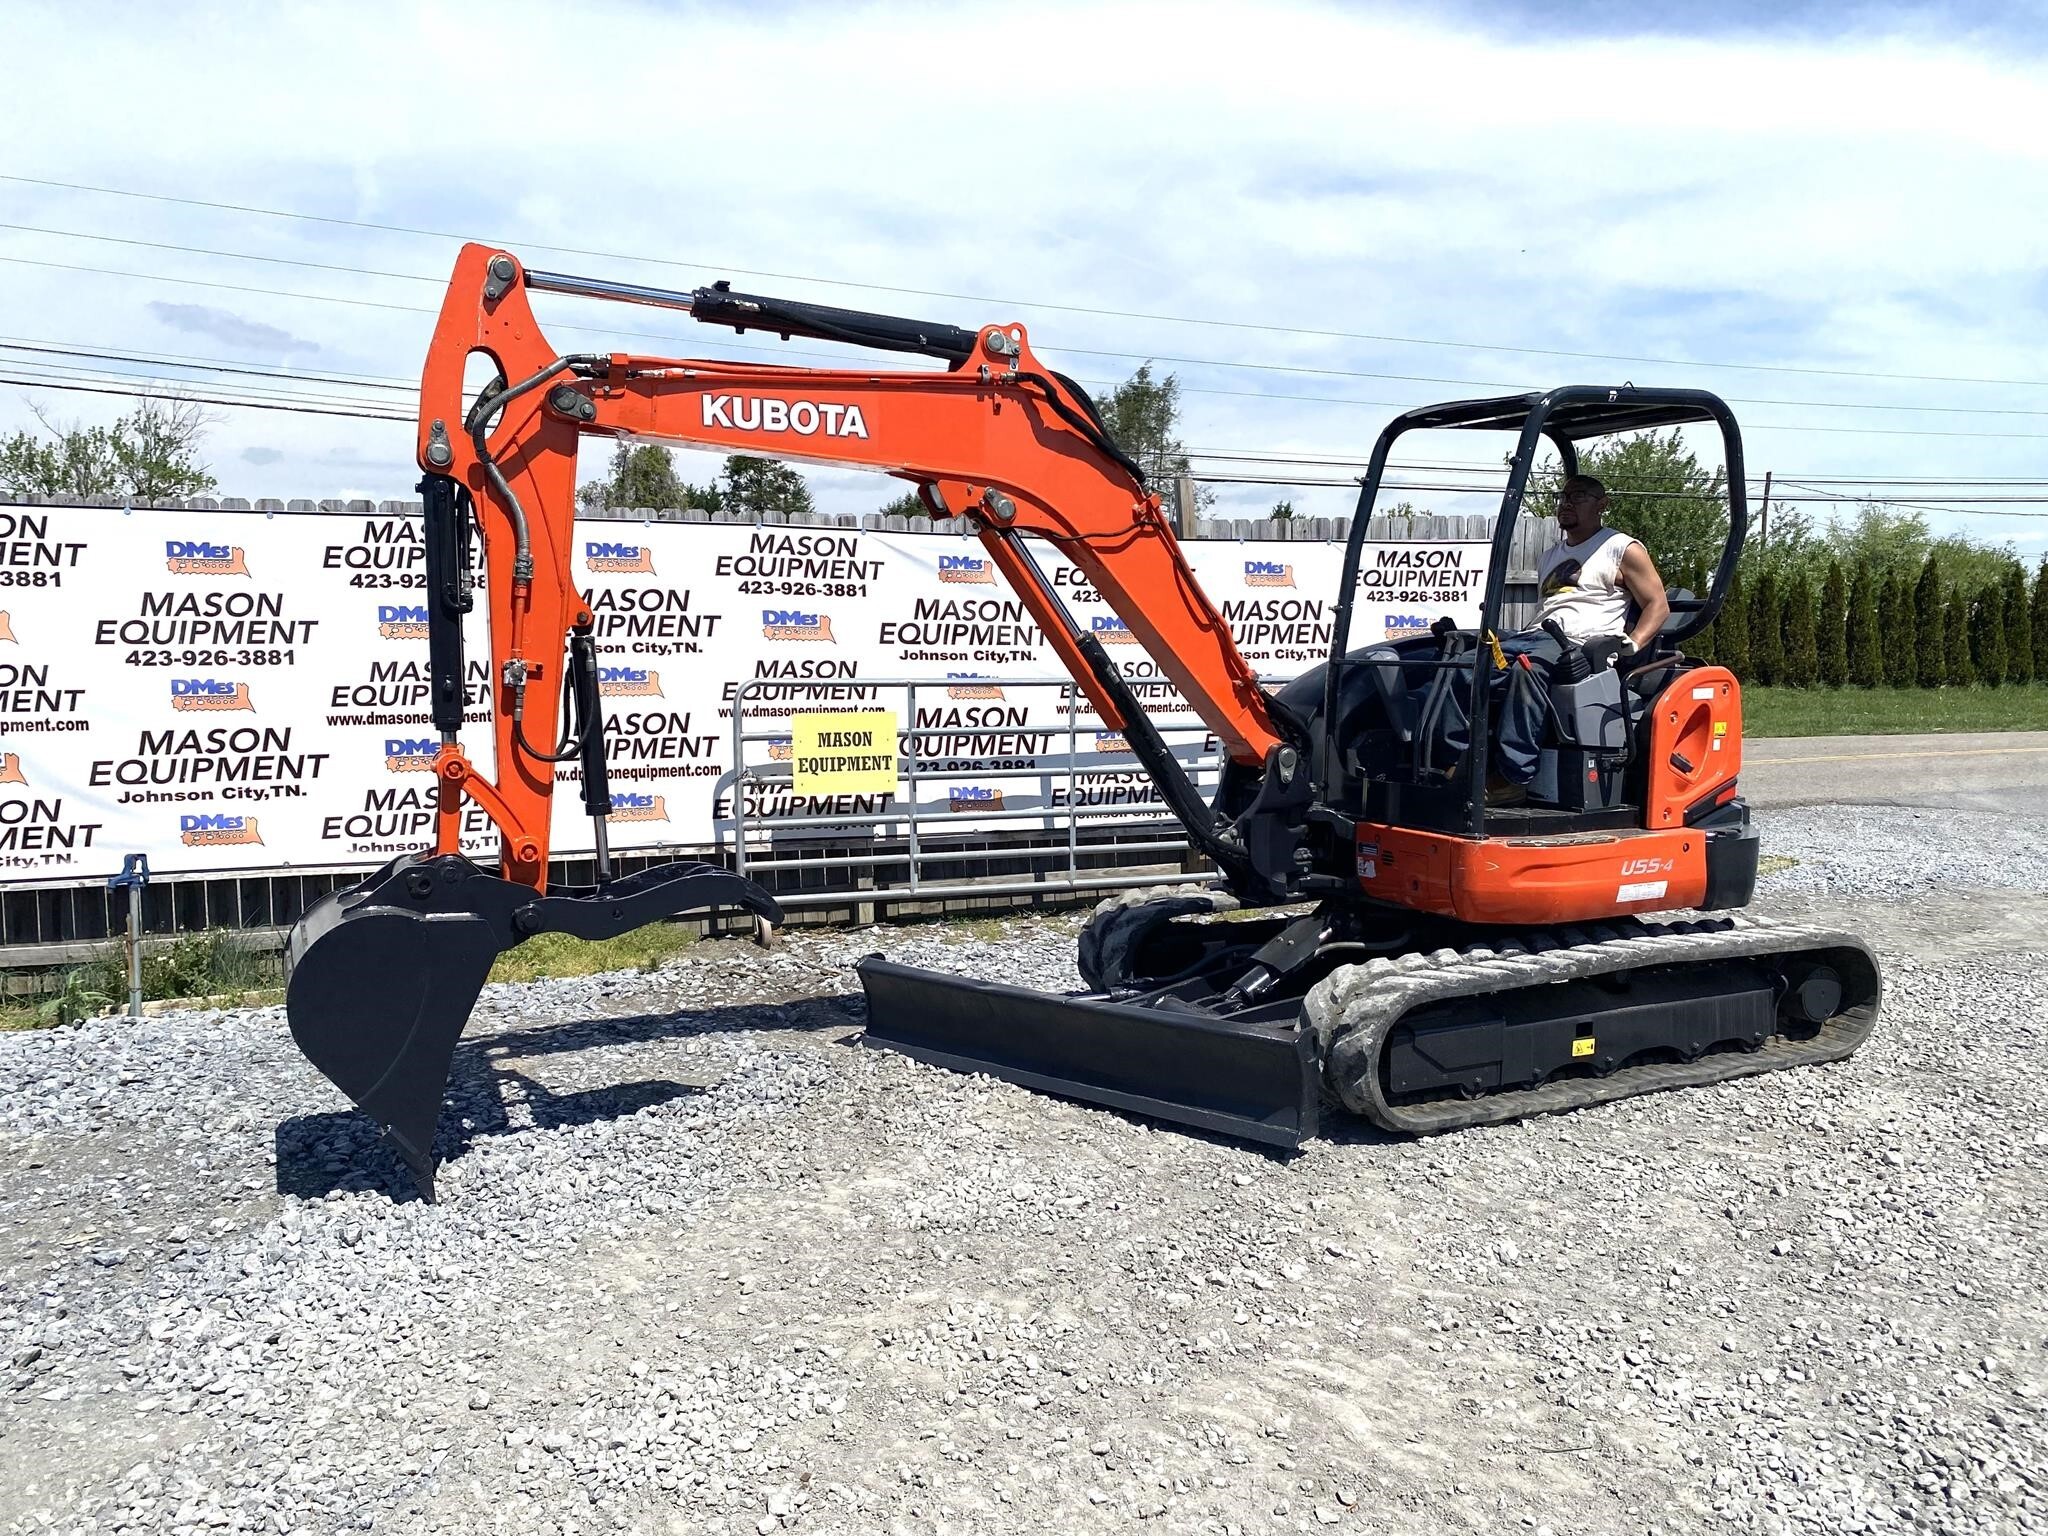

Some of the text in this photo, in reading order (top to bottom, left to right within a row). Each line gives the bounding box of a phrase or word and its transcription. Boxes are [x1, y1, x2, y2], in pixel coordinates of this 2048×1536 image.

[701, 393, 869, 440] KUBOTA
[750, 533, 858, 557] MASON
[715, 556, 884, 580] EQUIPMENT
[1376, 551, 1462, 568] MASON
[738, 581, 867, 597] 423-926-3881
[1367, 591, 1467, 602] 423-926-3881
[140, 592, 283, 617] MASON
[913, 598, 1024, 623] MASON
[1222, 600, 1323, 621] MASON
[95, 619, 319, 645] EQUIPMENT
[879, 622, 1046, 646] EQUIPMENT
[125, 650, 295, 667] 423-926-3881
[632, 642, 703, 656] City,TN.
[899, 649, 1037, 663] Johnson City,TN.
[755, 660, 857, 678] MASON
[604, 712, 690, 736] ASON
[916, 707, 1028, 728] MASON
[138, 727, 292, 756] MASON
[818, 731, 872, 747] MASON
[899, 734, 1055, 757] QUIPMENT
[89, 754, 329, 786] EQUIPMENT
[798, 755, 892, 775] EQUIPMENT
[117, 785, 307, 804] Johnson City,TN.
[713, 794, 893, 820] EQUIPMENT
[0, 853, 78, 868] ity,TN.
